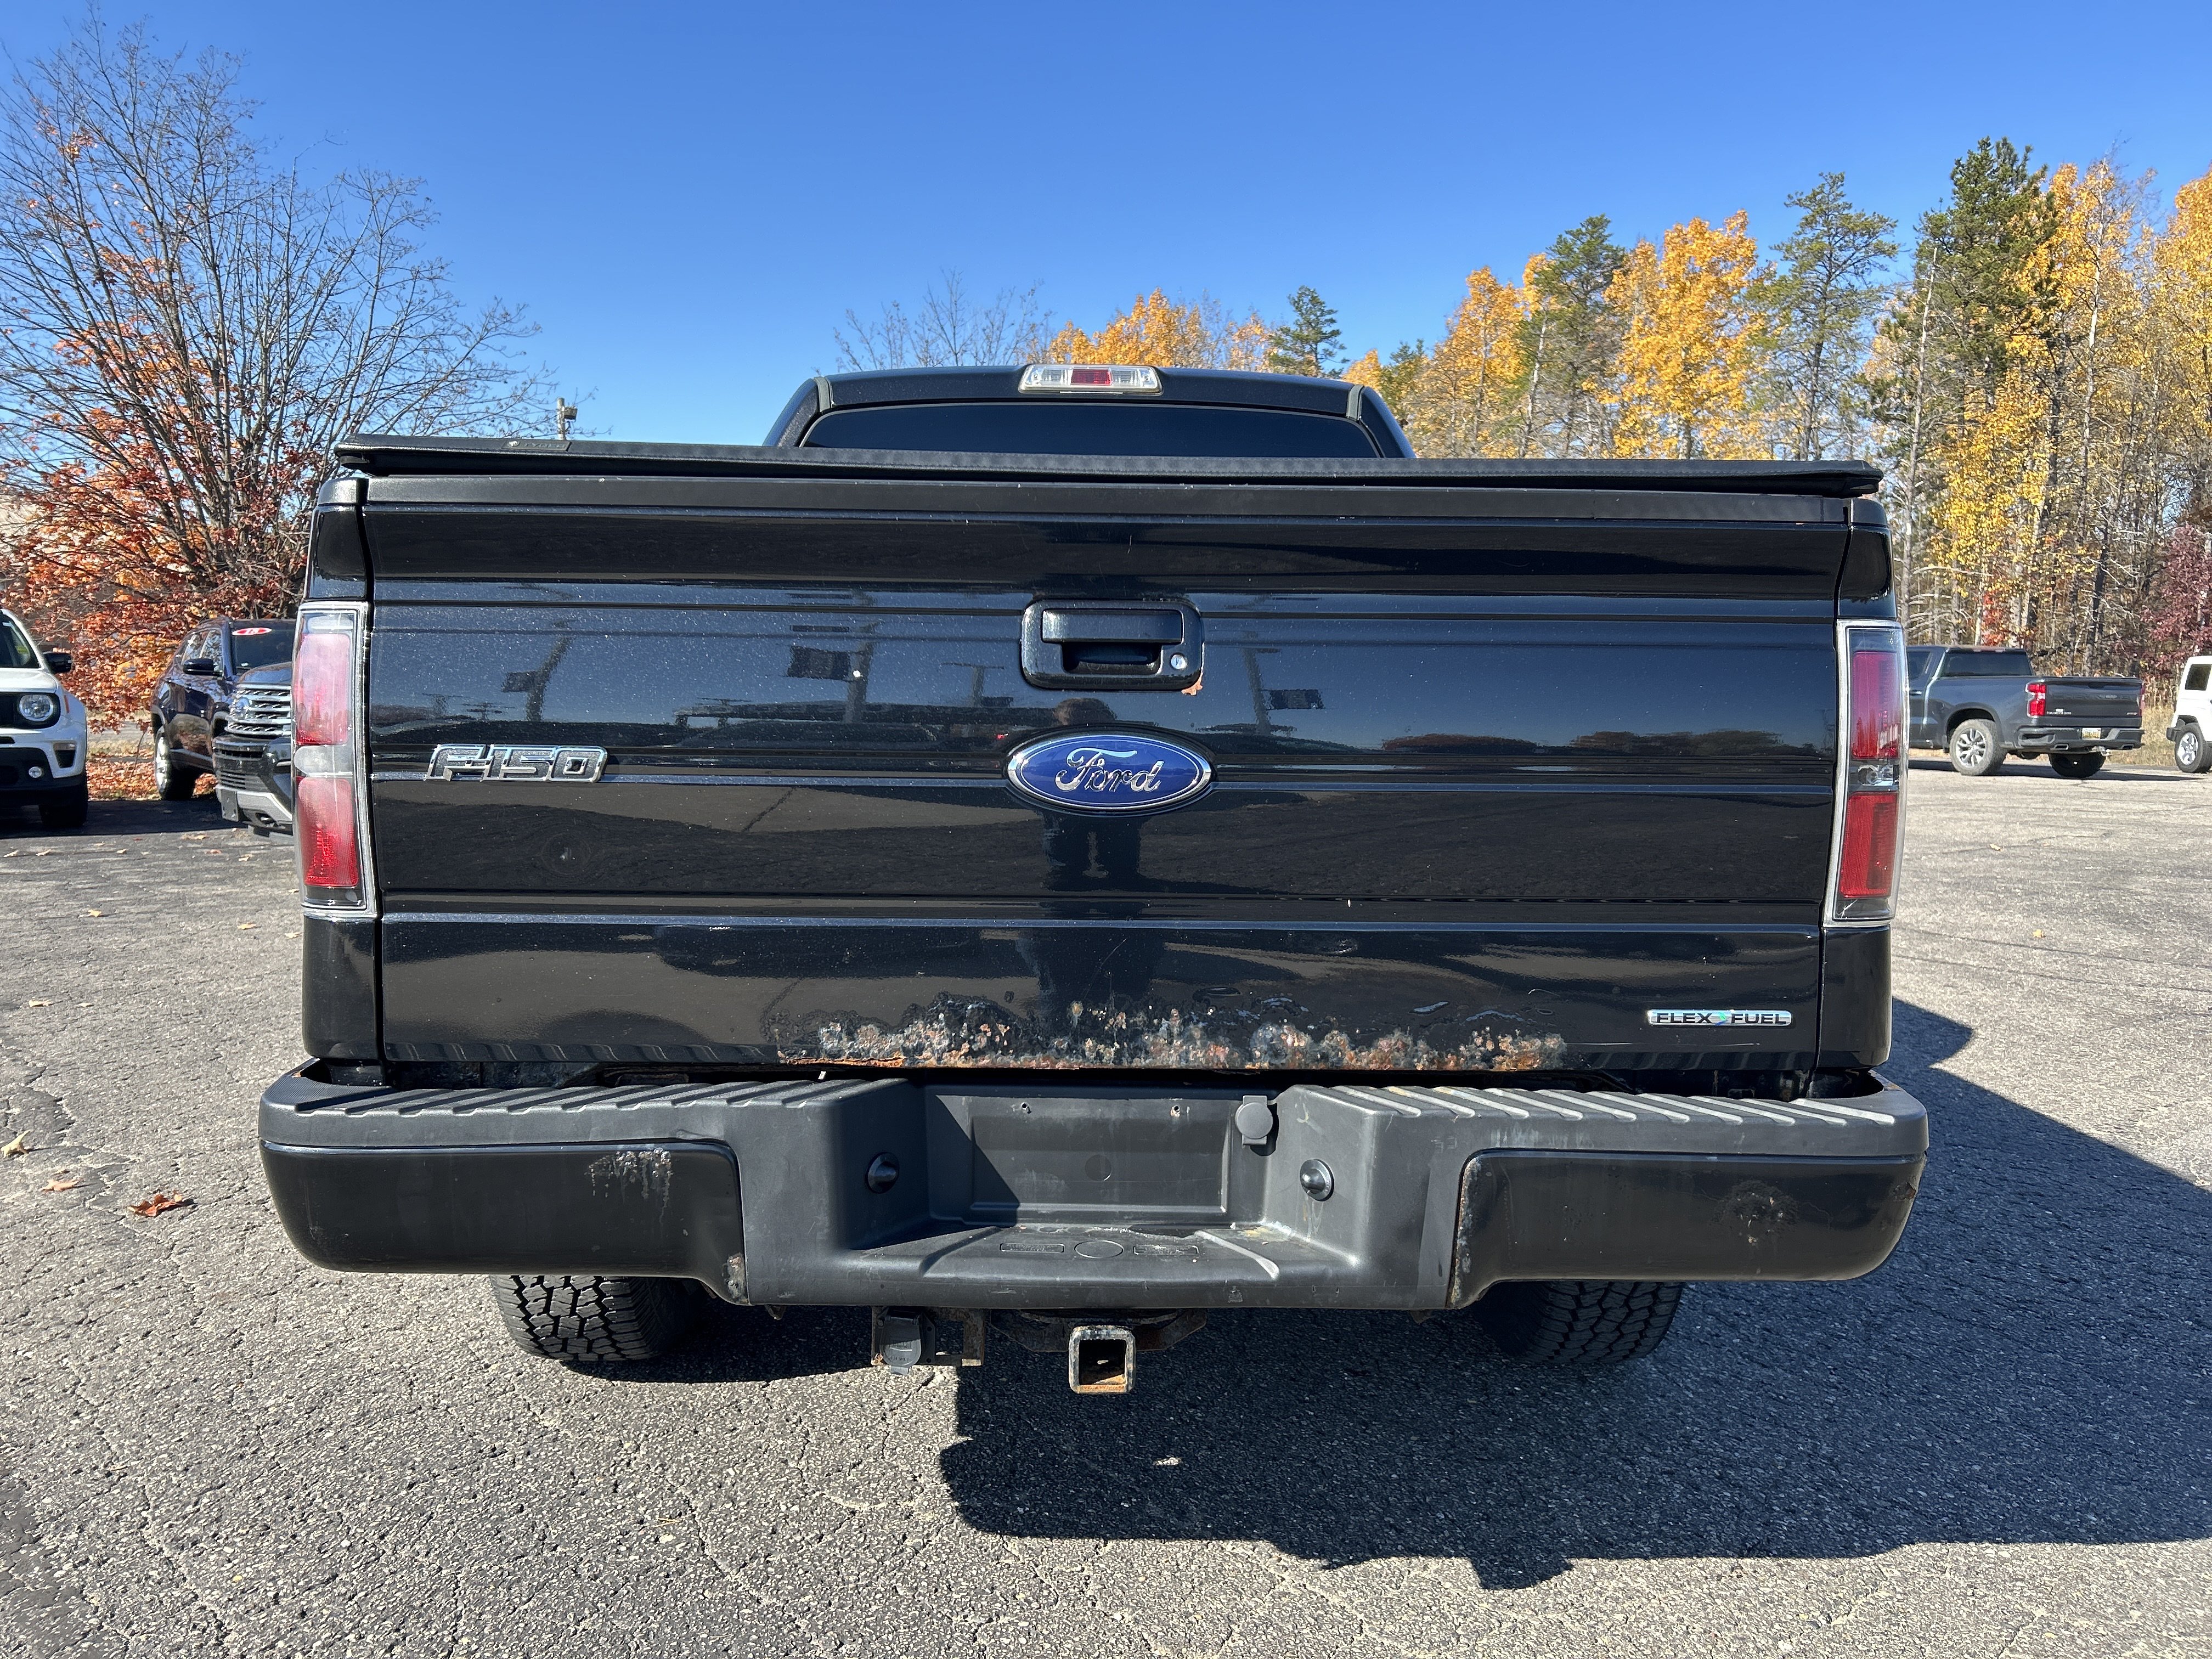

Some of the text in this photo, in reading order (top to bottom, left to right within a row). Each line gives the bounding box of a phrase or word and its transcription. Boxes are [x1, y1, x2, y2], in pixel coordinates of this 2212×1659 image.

[423, 744, 608, 782] F-150
[1055, 747, 1164, 792] Ford
[1656, 1013, 1787, 1024] FLEX FUEL
